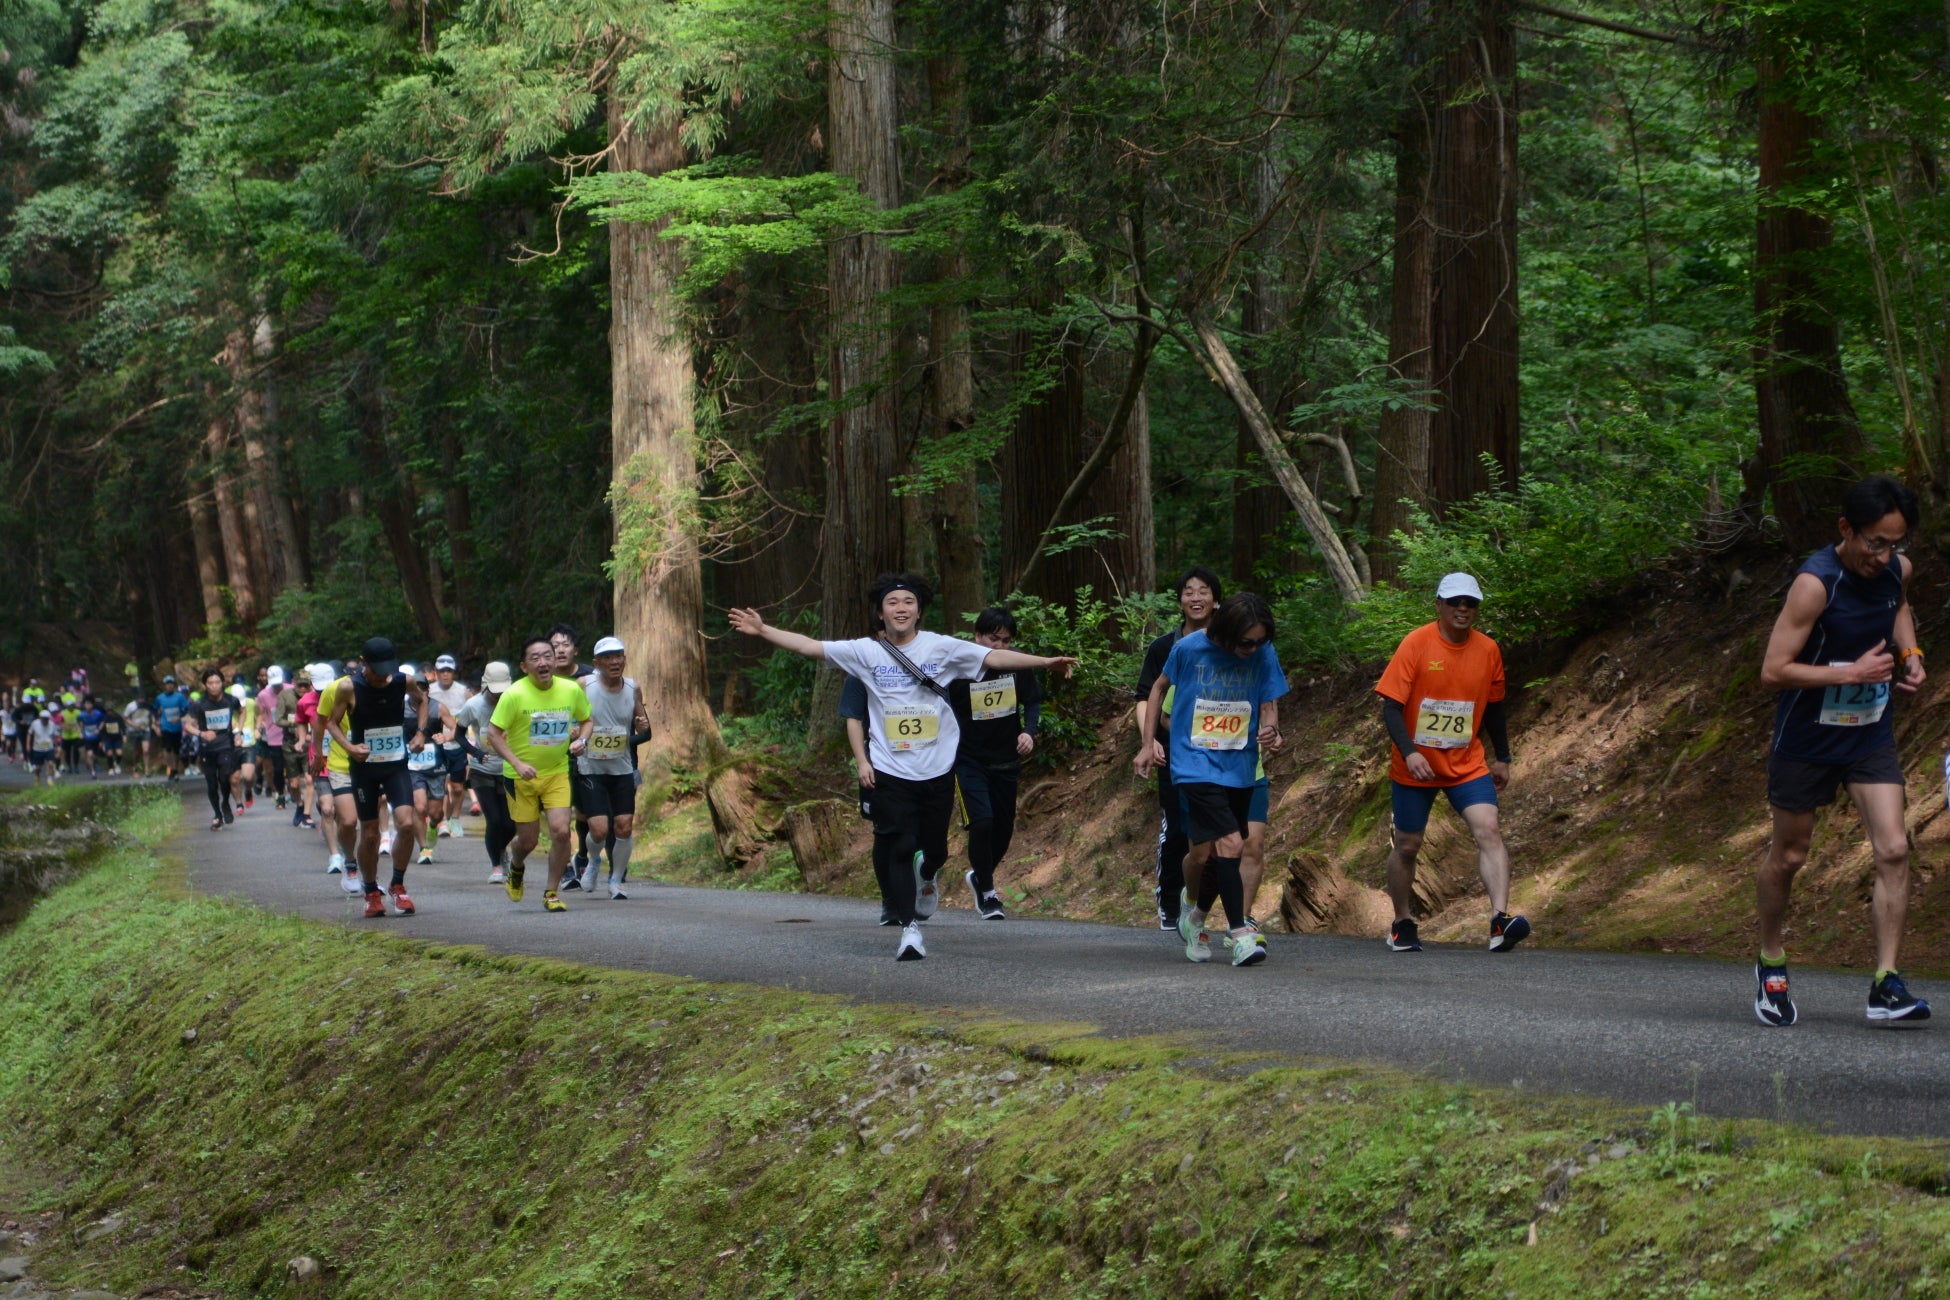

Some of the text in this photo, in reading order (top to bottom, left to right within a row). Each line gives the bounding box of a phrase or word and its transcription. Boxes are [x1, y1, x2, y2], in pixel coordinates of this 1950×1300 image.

[983, 691, 1004, 707] 67
[533, 721, 568, 735] 1217
[898, 718, 922, 735] 63
[1202, 715, 1241, 733] 840
[1426, 714, 1465, 733] 278
[368, 737, 402, 751] 1353
[594, 736, 621, 748] 625
